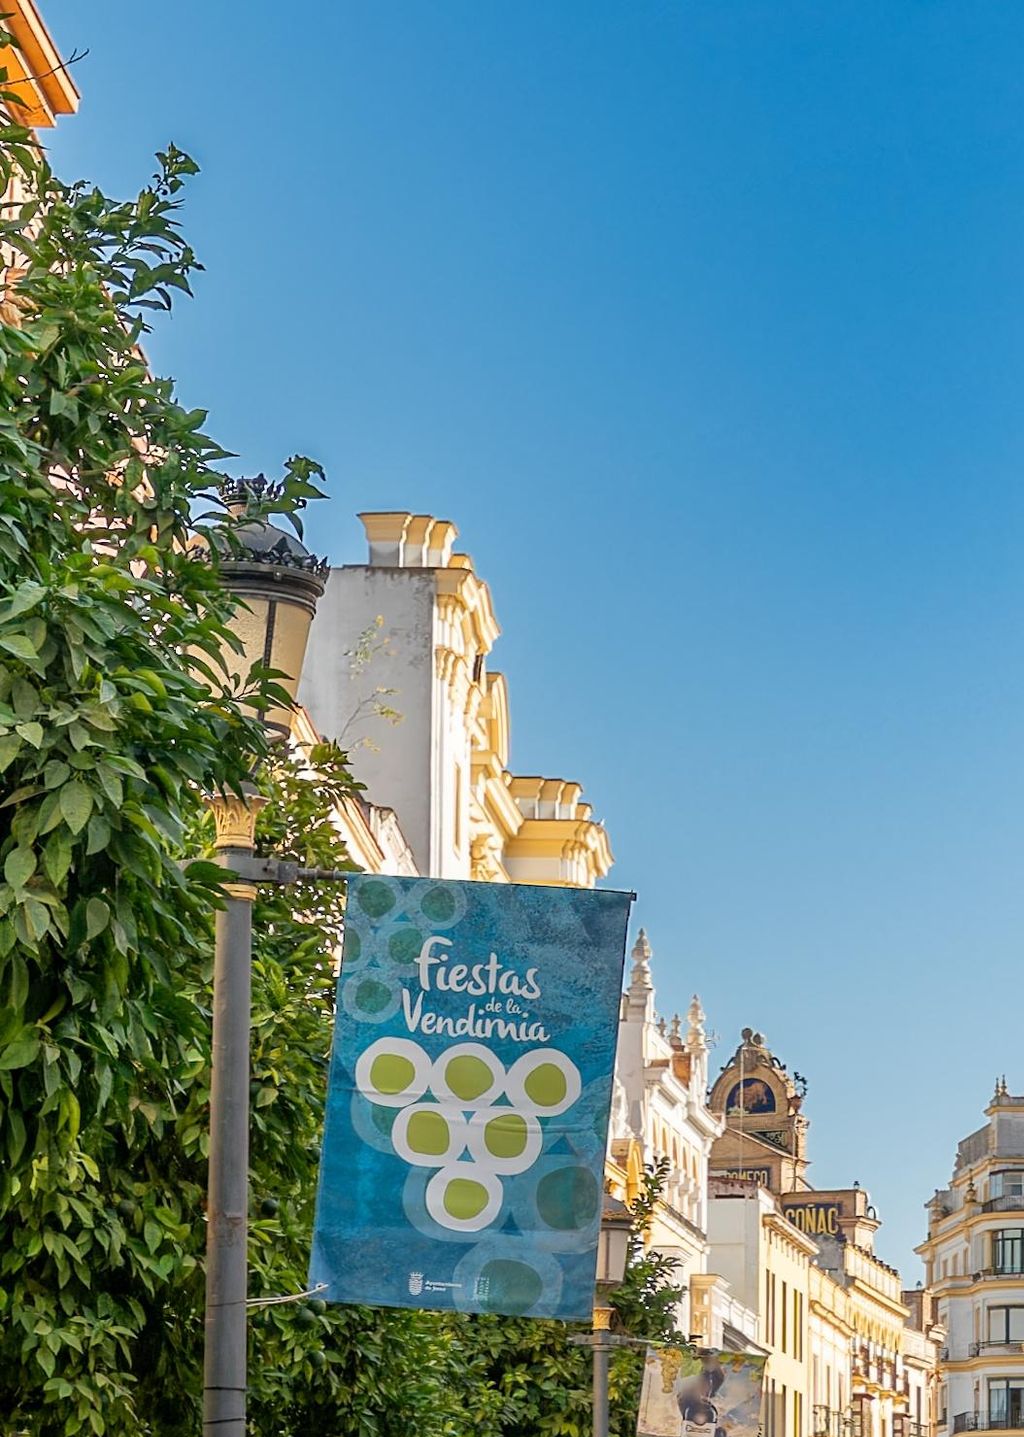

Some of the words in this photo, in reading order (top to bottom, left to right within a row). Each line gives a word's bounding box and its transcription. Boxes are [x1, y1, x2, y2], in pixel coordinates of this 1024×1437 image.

[402, 988, 551, 1042] Vendimia
[485, 997, 503, 1013] de
[505, 998, 522, 1015] la
[784, 1203, 839, 1235] COÑAC
